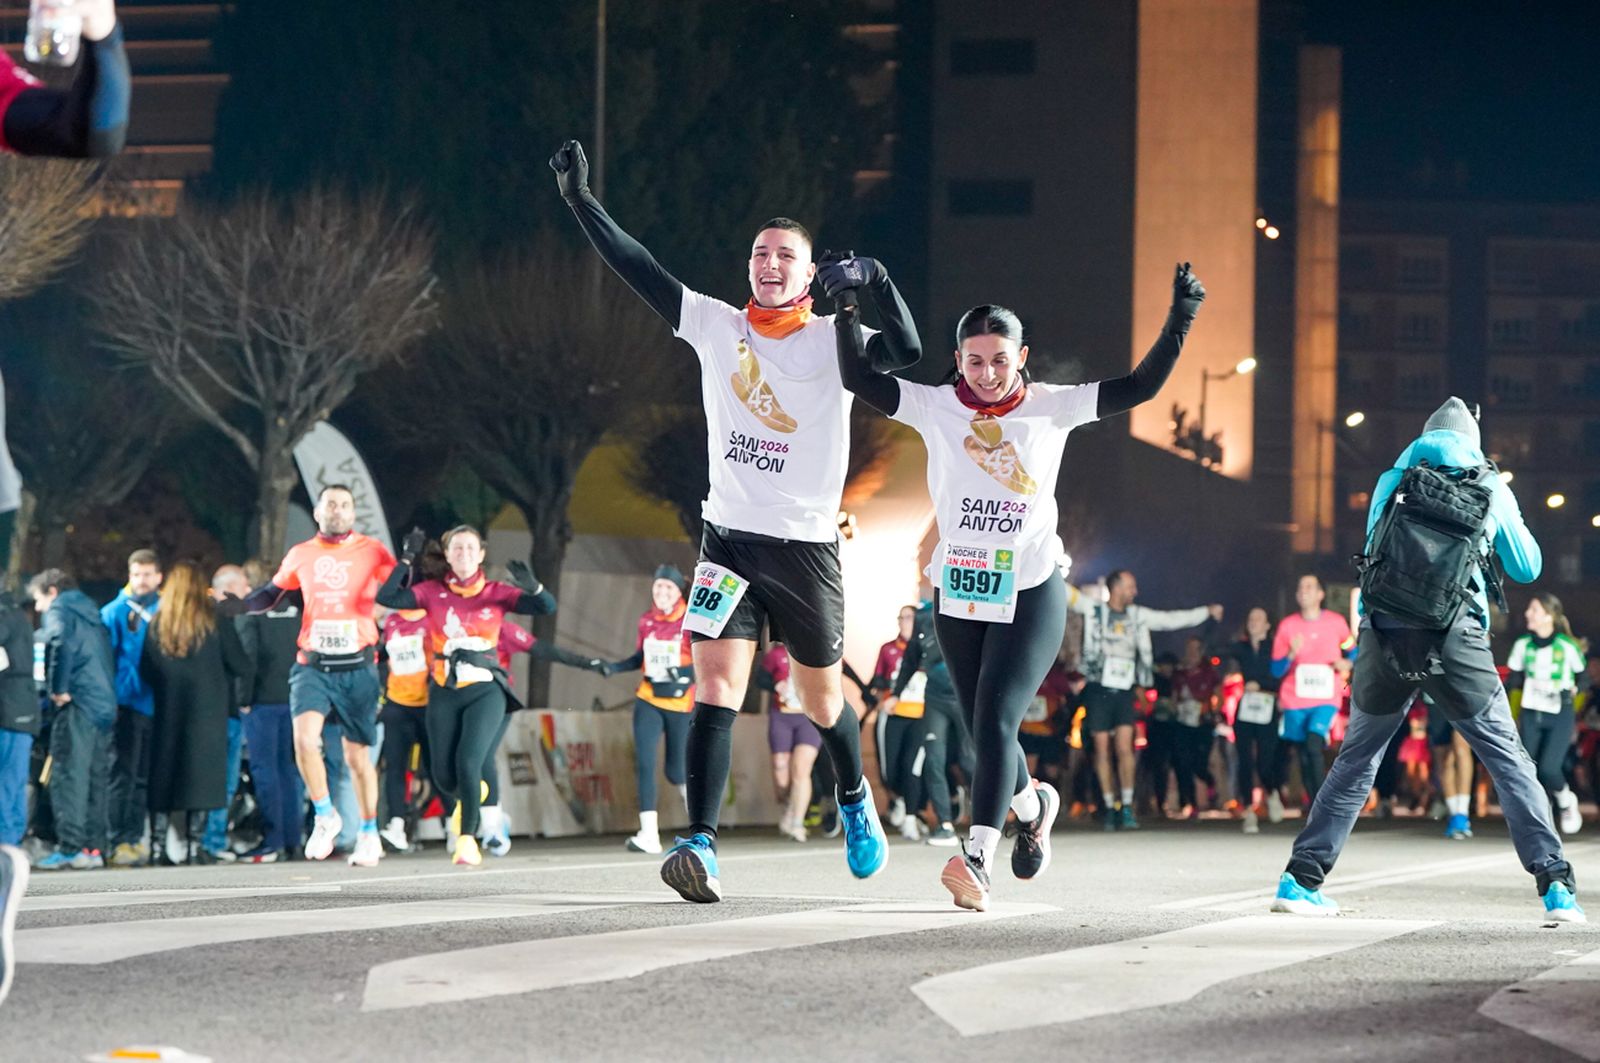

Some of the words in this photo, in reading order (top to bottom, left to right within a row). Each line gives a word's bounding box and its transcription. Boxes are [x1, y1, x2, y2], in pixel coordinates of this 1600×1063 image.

[748, 381, 774, 416] 43
[729, 430, 759, 452] SAN
[760, 440, 789, 453] 2026
[724, 447, 785, 473] ANTÓN
[961, 497, 1001, 515] SAN
[1001, 501, 1030, 513] 202
[952, 548, 977, 559] NOCHE
[977, 551, 988, 559] DE
[950, 567, 1003, 595] 9597
[693, 586, 723, 611] 98
